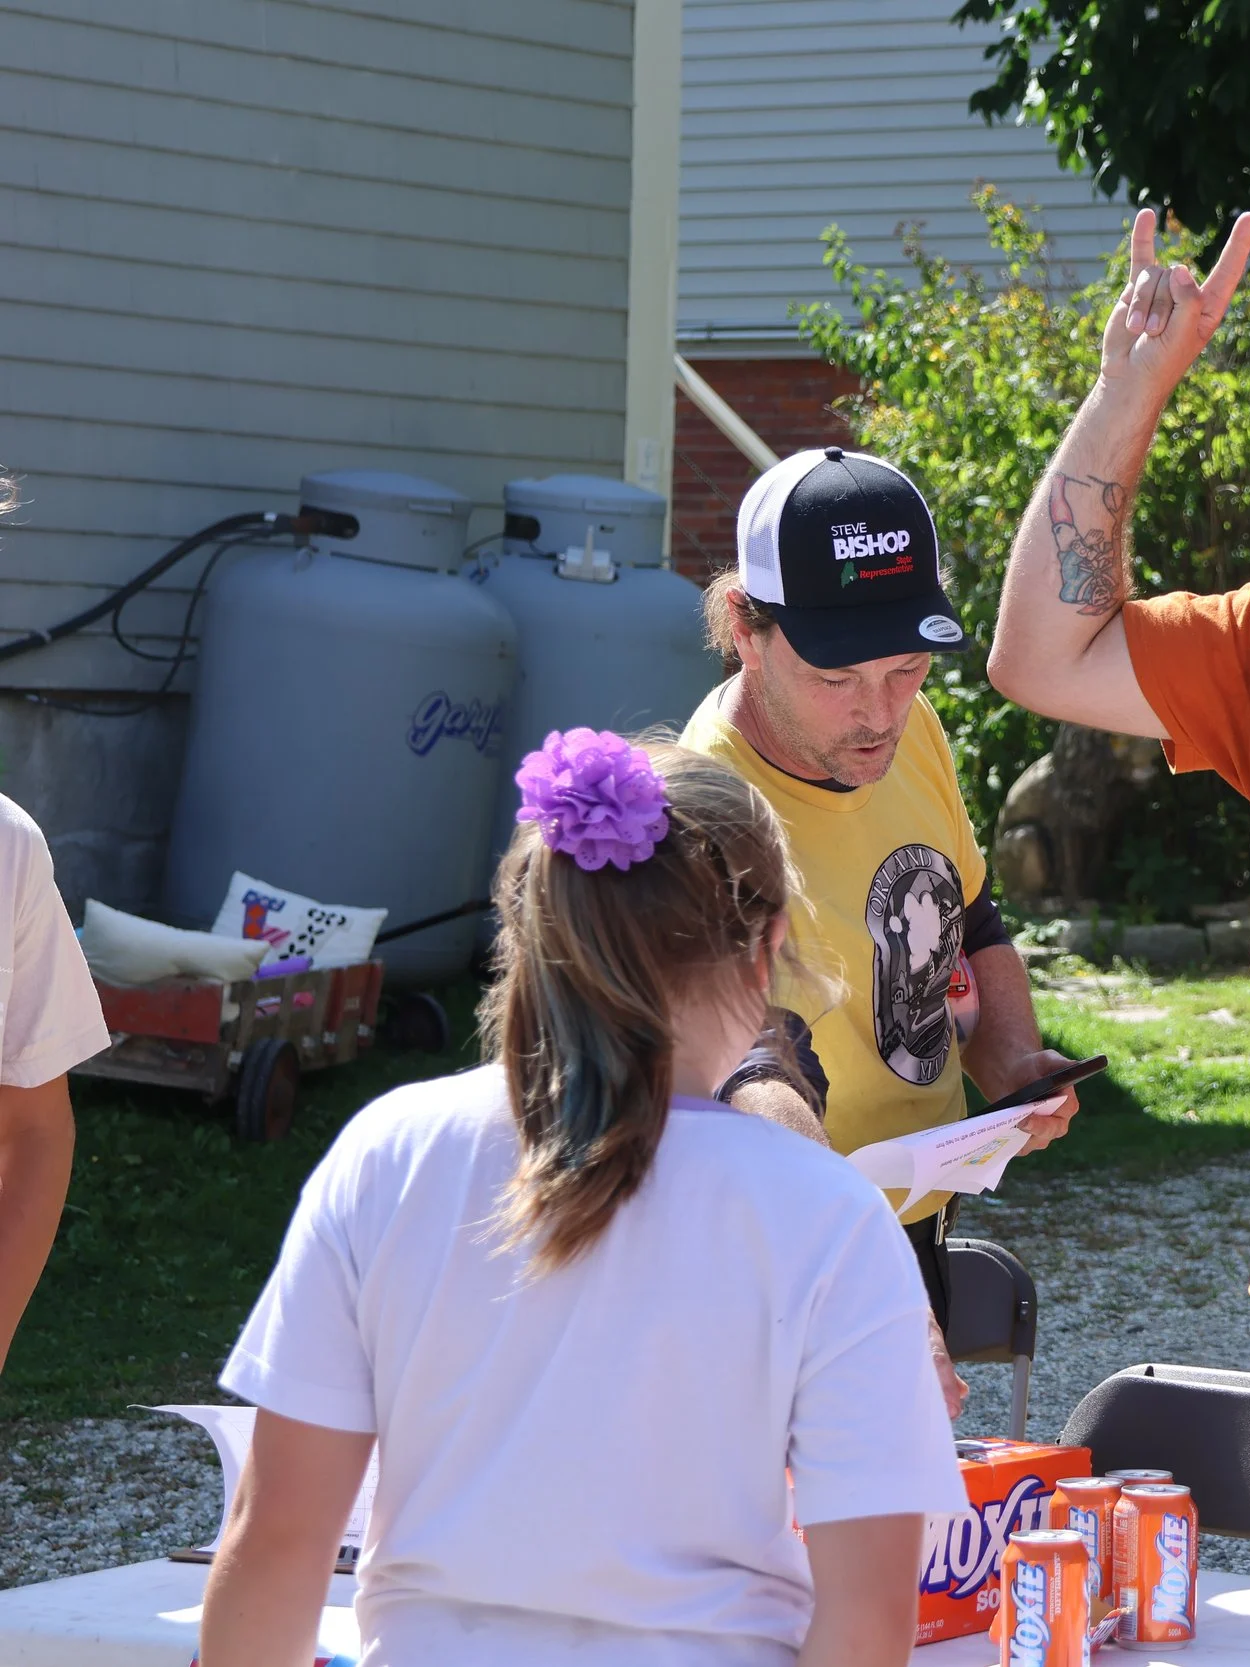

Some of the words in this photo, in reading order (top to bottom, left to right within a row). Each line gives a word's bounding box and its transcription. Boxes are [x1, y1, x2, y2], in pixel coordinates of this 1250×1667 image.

[831, 522, 867, 536] STEVE
[833, 530, 910, 560] BISHOP
[860, 565, 914, 580] Representative
[870, 847, 932, 917] ORLAND
[919, 1473, 1055, 1600] MOXI
[1152, 1512, 1192, 1633] MOXIE
